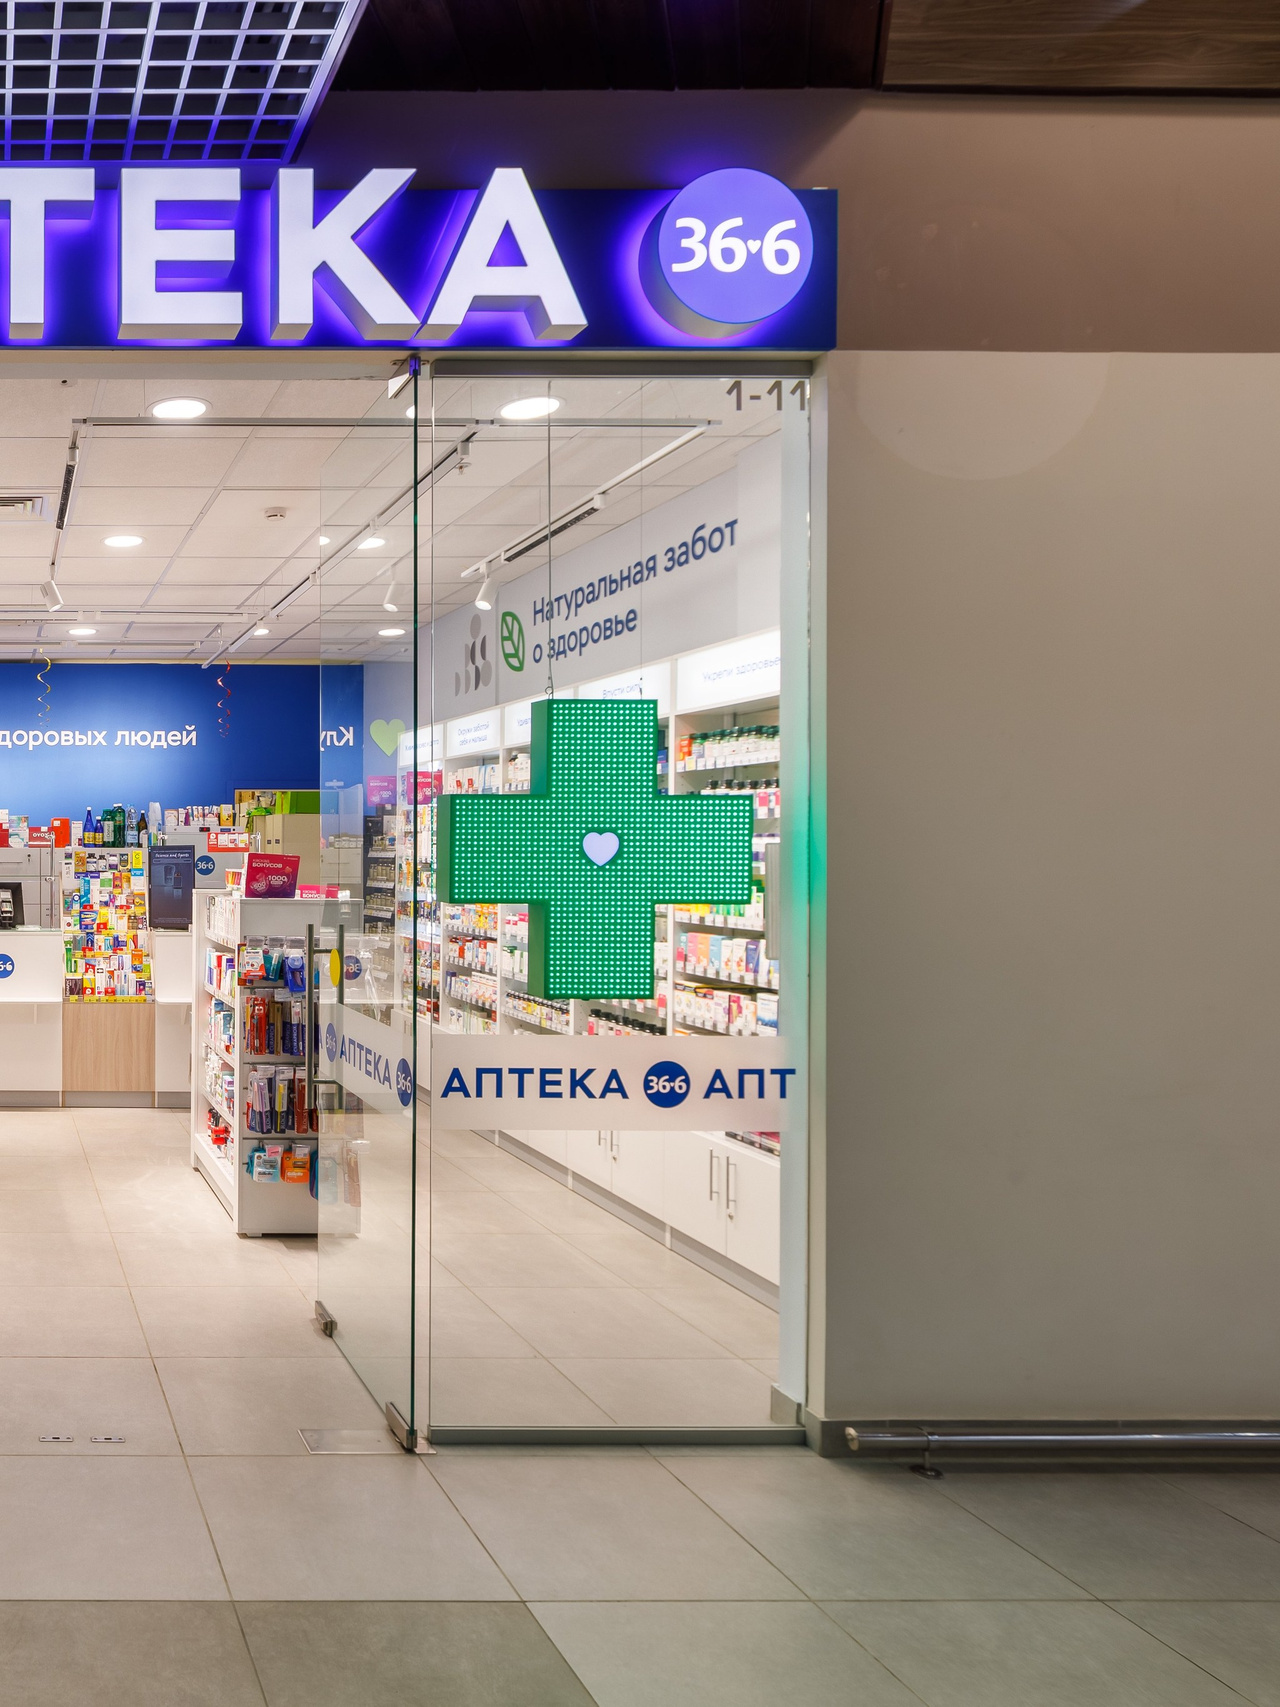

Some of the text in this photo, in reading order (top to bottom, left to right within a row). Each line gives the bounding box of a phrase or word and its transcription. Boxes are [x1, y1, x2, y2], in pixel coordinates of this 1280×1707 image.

[725, 380, 807, 411] 1-11
[532, 554, 657, 626] Натуральная
[532, 608, 638, 663] о здоровье
[114, 725, 197, 748] людей
[340, 1034, 392, 1090] АПТЕКА
[440, 1067, 629, 1099] АПТЕКА
[703, 1068, 796, 1099] АПТ
